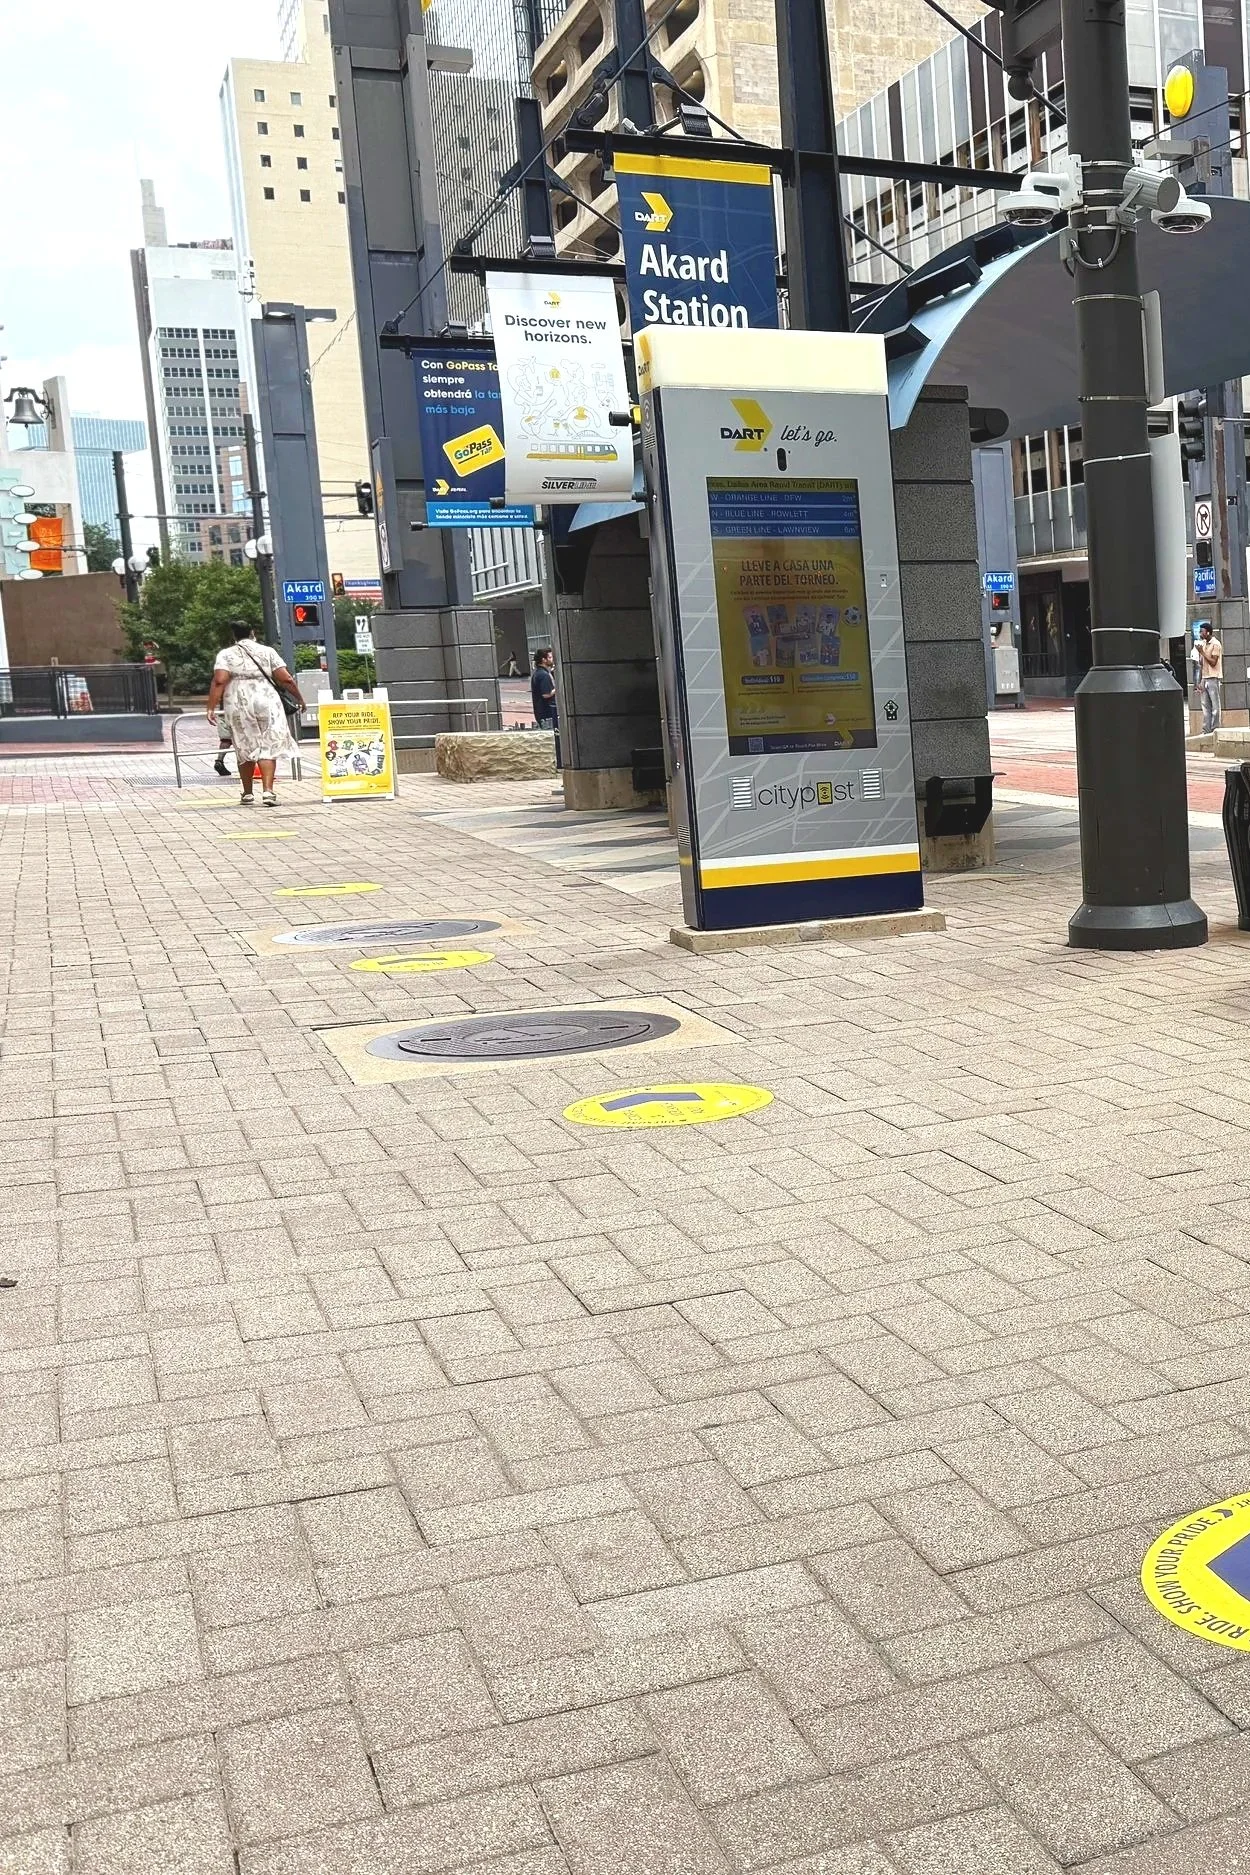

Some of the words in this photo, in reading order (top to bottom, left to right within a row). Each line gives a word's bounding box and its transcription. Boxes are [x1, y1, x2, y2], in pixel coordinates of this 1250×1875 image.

[640, 243, 729, 284] Akard
[643, 289, 749, 328] Station
[505, 314, 570, 328] Discover
[576, 320, 607, 330] new
[524, 330, 592, 345] horizons.
[421, 360, 443, 369] Con
[446, 361, 486, 371] GoPass
[422, 375, 465, 385] siempre
[424, 389, 472, 399] obtendrá
[474, 391, 485, 399] la
[425, 405, 448, 414] más
[451, 405, 476, 415] baja
[720, 427, 765, 441] DART
[780, 424, 811, 442] let's
[815, 430, 838, 446] go.
[454, 437, 493, 460] GoPass
[741, 560, 771, 572] LLEVE
[773, 560, 781, 572] A
[783, 560, 810, 572] CASA
[813, 560, 834, 571] UNA
[739, 575, 771, 586] PARTE
[774, 575, 792, 586] DEL
[987, 574, 1013, 583] Akard
[1194, 571, 1214, 582] Pacific
[286, 584, 322, 593] Akard
[1167, 1517, 1223, 1546] PRIDE.
[1154, 1548, 1184, 1578] YOUR
[1155, 1580, 1202, 1615] SHOW
[1194, 1611, 1250, 1640] RIDE.
